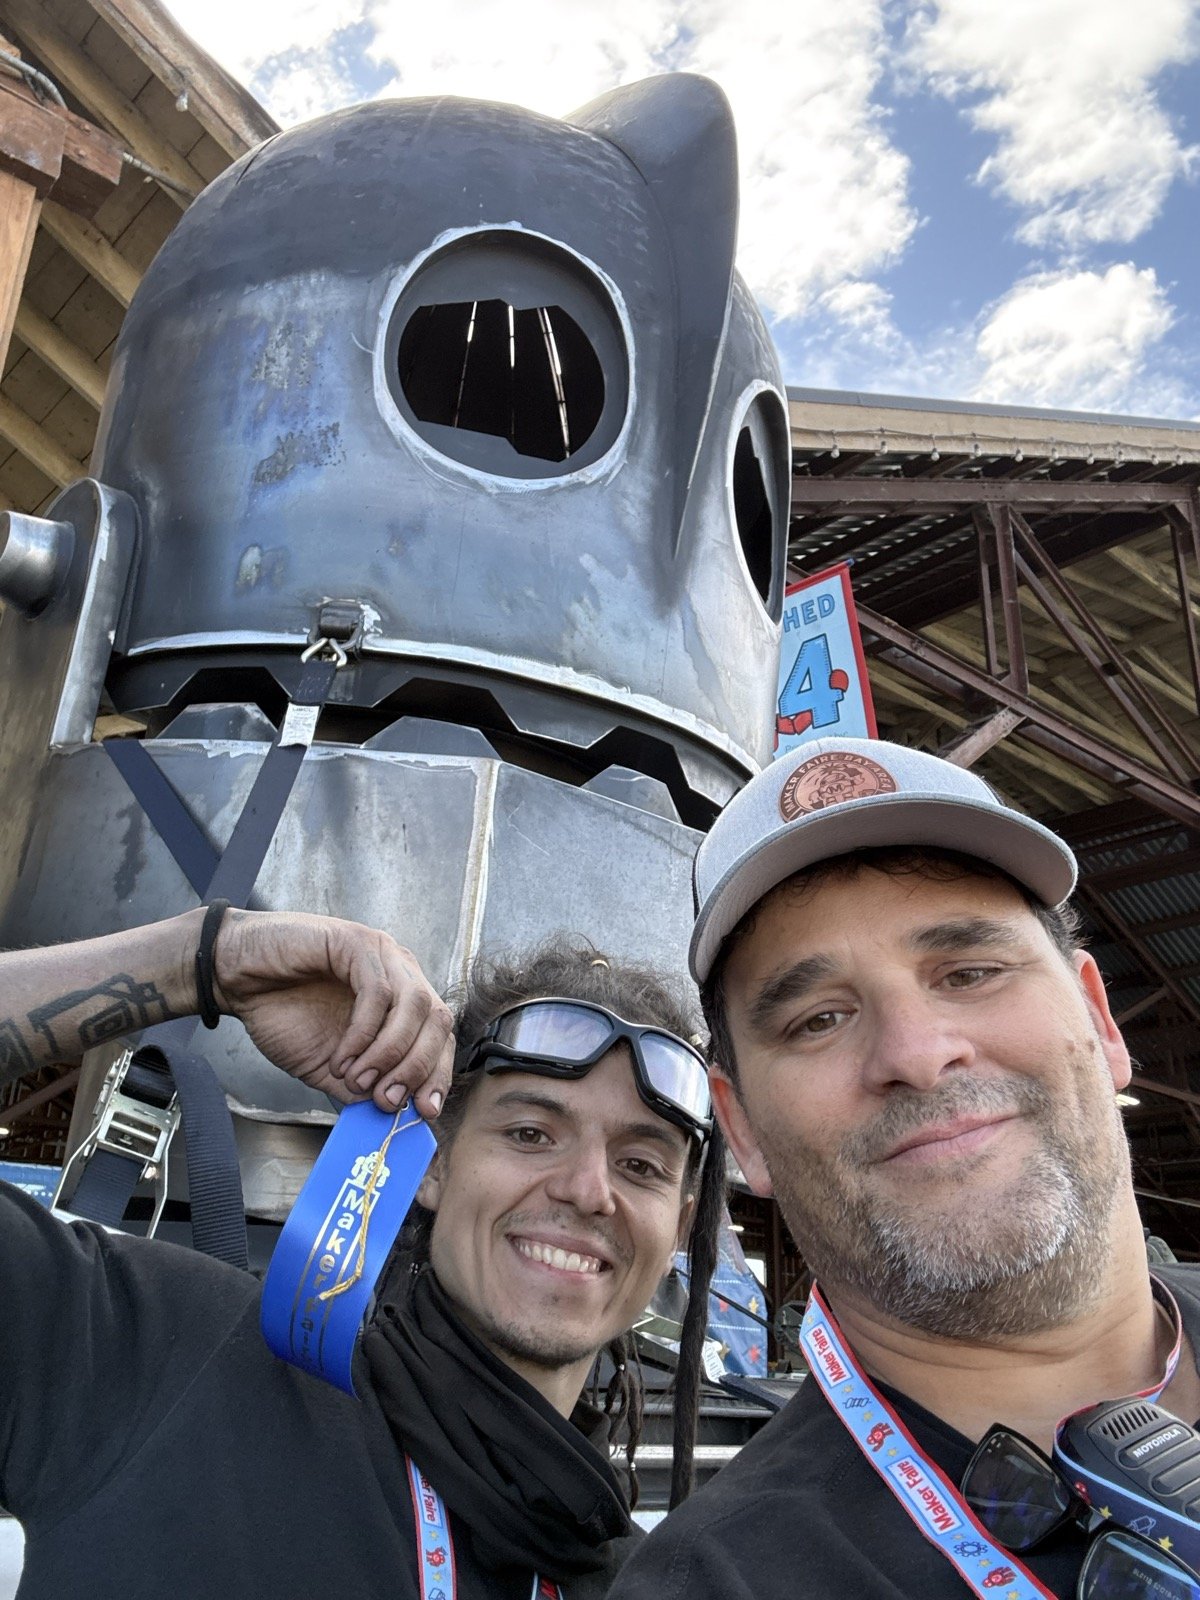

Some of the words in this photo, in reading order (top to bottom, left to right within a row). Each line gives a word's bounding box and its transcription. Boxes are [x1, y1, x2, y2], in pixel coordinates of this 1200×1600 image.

[783, 593, 836, 633] HED
[778, 632, 845, 730] 4
[784, 776, 800, 813] MAKER
[798, 754, 838, 775] FAIRE
[844, 754, 873, 767] BAY
[871, 766, 892, 788] AREA
[812, 1327, 833, 1355] Faire
[823, 1353, 848, 1384] Maker
[1133, 1428, 1182, 1459] MOTOROLA
[895, 1459, 922, 1490] Faire
[423, 1494, 436, 1522] Faire
[917, 1483, 956, 1533] Maker
